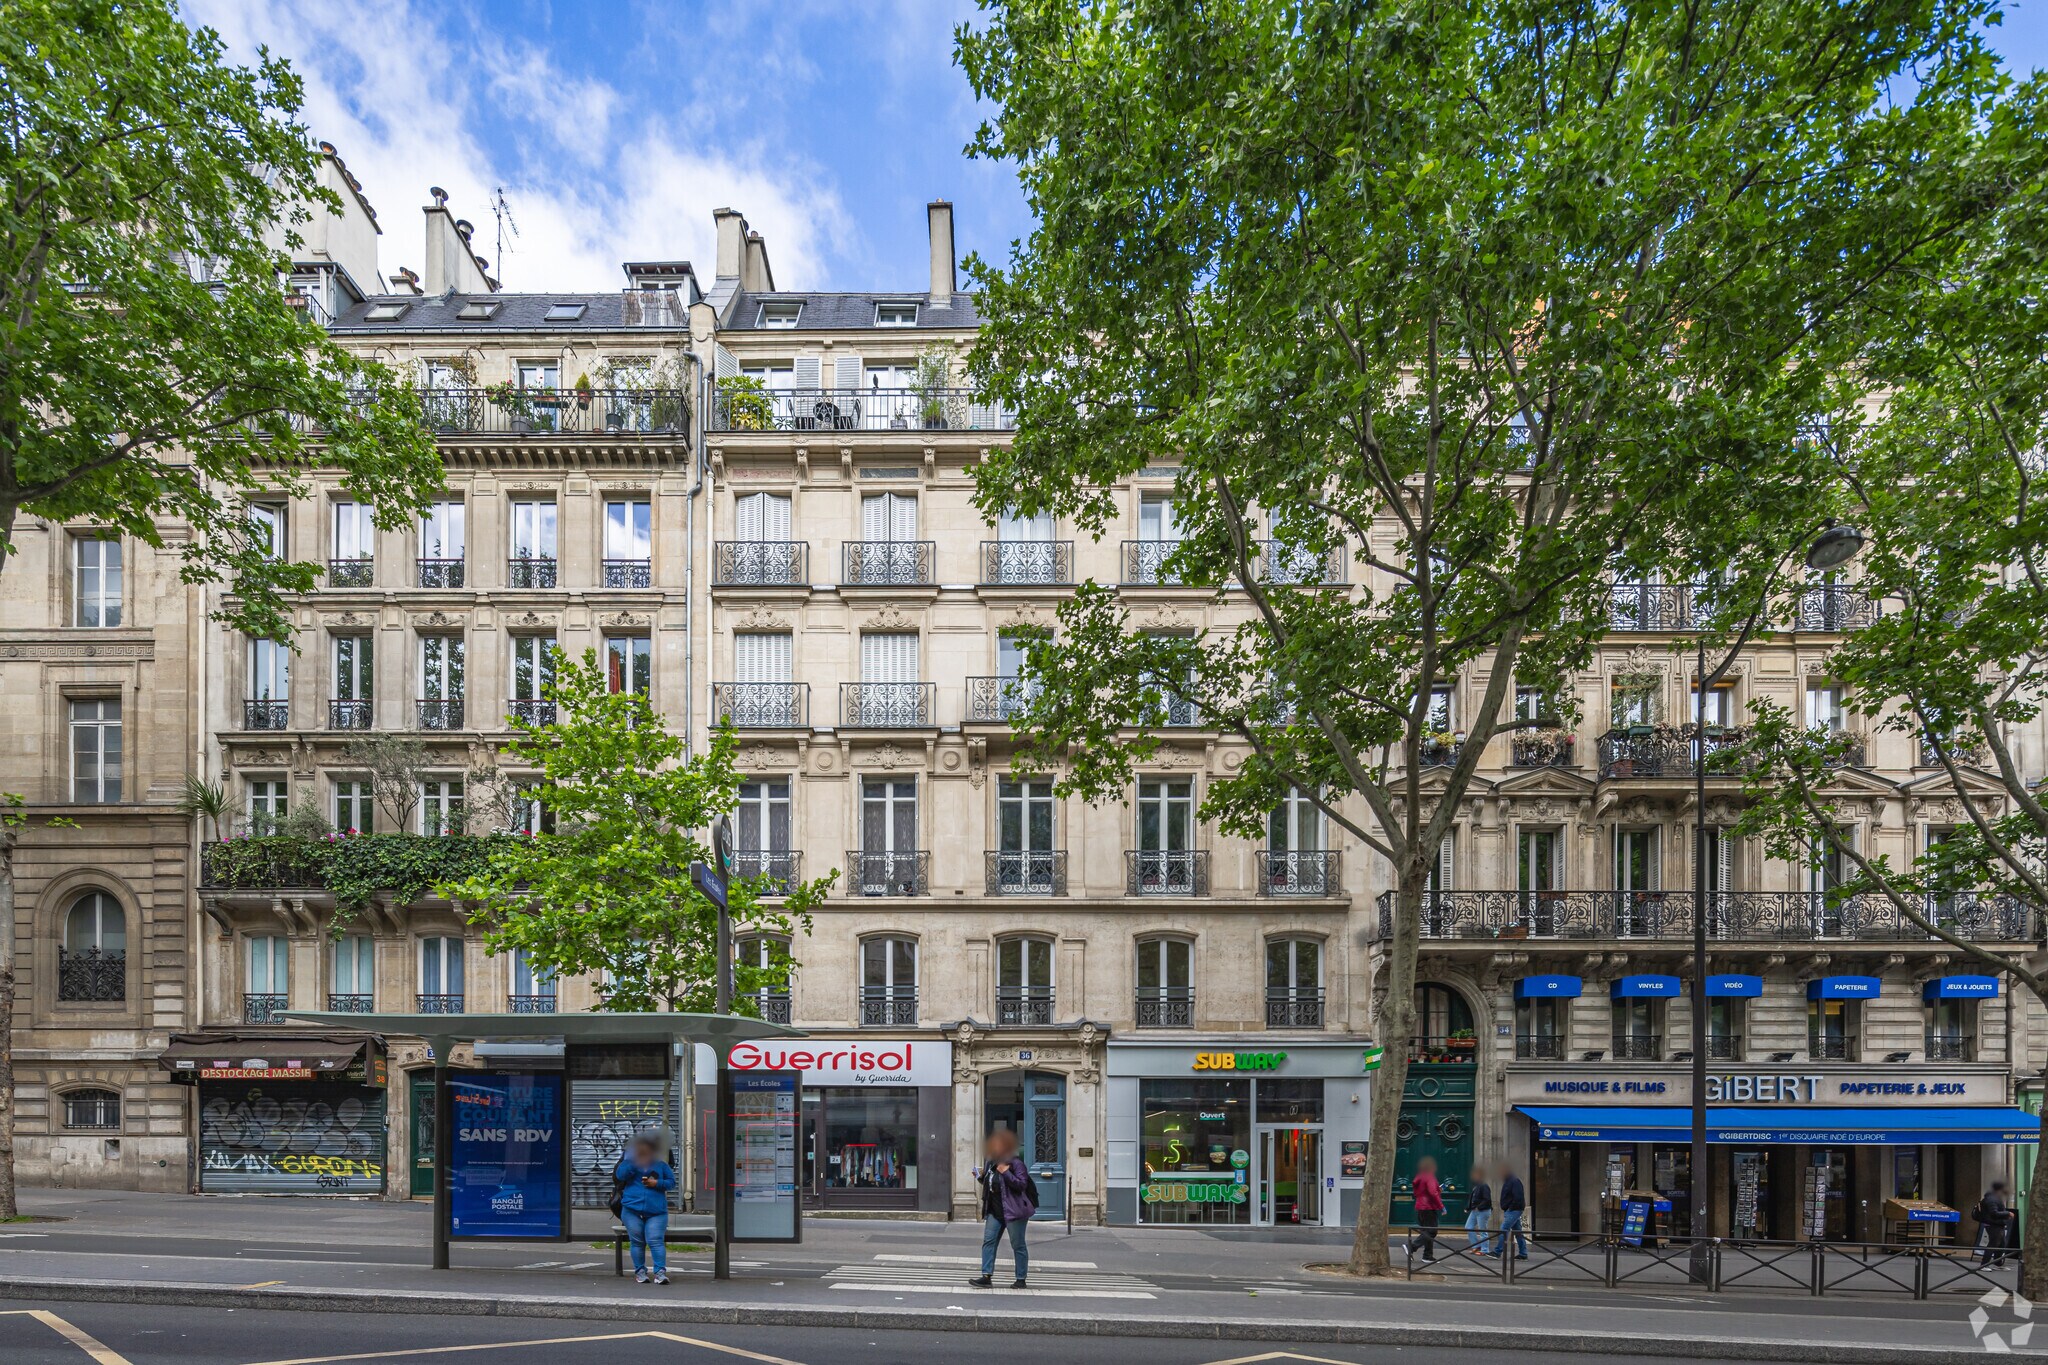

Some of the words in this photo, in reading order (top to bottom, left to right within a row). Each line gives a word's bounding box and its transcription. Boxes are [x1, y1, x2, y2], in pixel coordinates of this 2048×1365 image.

[1499, 1026, 1510, 1034] 34
[728, 1043, 912, 1071] Guerrisol
[1021, 1051, 1030, 1059] 36
[1193, 1051, 1288, 1072] SUBWAY
[202, 1069, 270, 1078] DESTOCKAGE
[272, 1069, 311, 1078] MASSIF
[760, 1079, 781, 1087] Écoles
[855, 1074, 866, 1083] by
[868, 1074, 912, 1083] Guerrida
[1545, 1081, 1609, 1093] MUSIQUE
[1612, 1082, 1621, 1093] &
[1625, 1082, 1666, 1093] FILMS
[1840, 1083, 1915, 1095] PAPETERIE
[1917, 1083, 1927, 1094] &
[1930, 1083, 1966, 1094] JEUX
[1200, 1111, 1226, 1119] Ouvert
[459, 1128, 507, 1142] SANS
[514, 1129, 553, 1142] RDV
[1790, 1133, 1828, 1141] DISQUAIRE
[1829, 1132, 1847, 1141] INDÉ
[1849, 1133, 1886, 1141] D'EUROPE
[1143, 1184, 1242, 1204] SUBWAY
